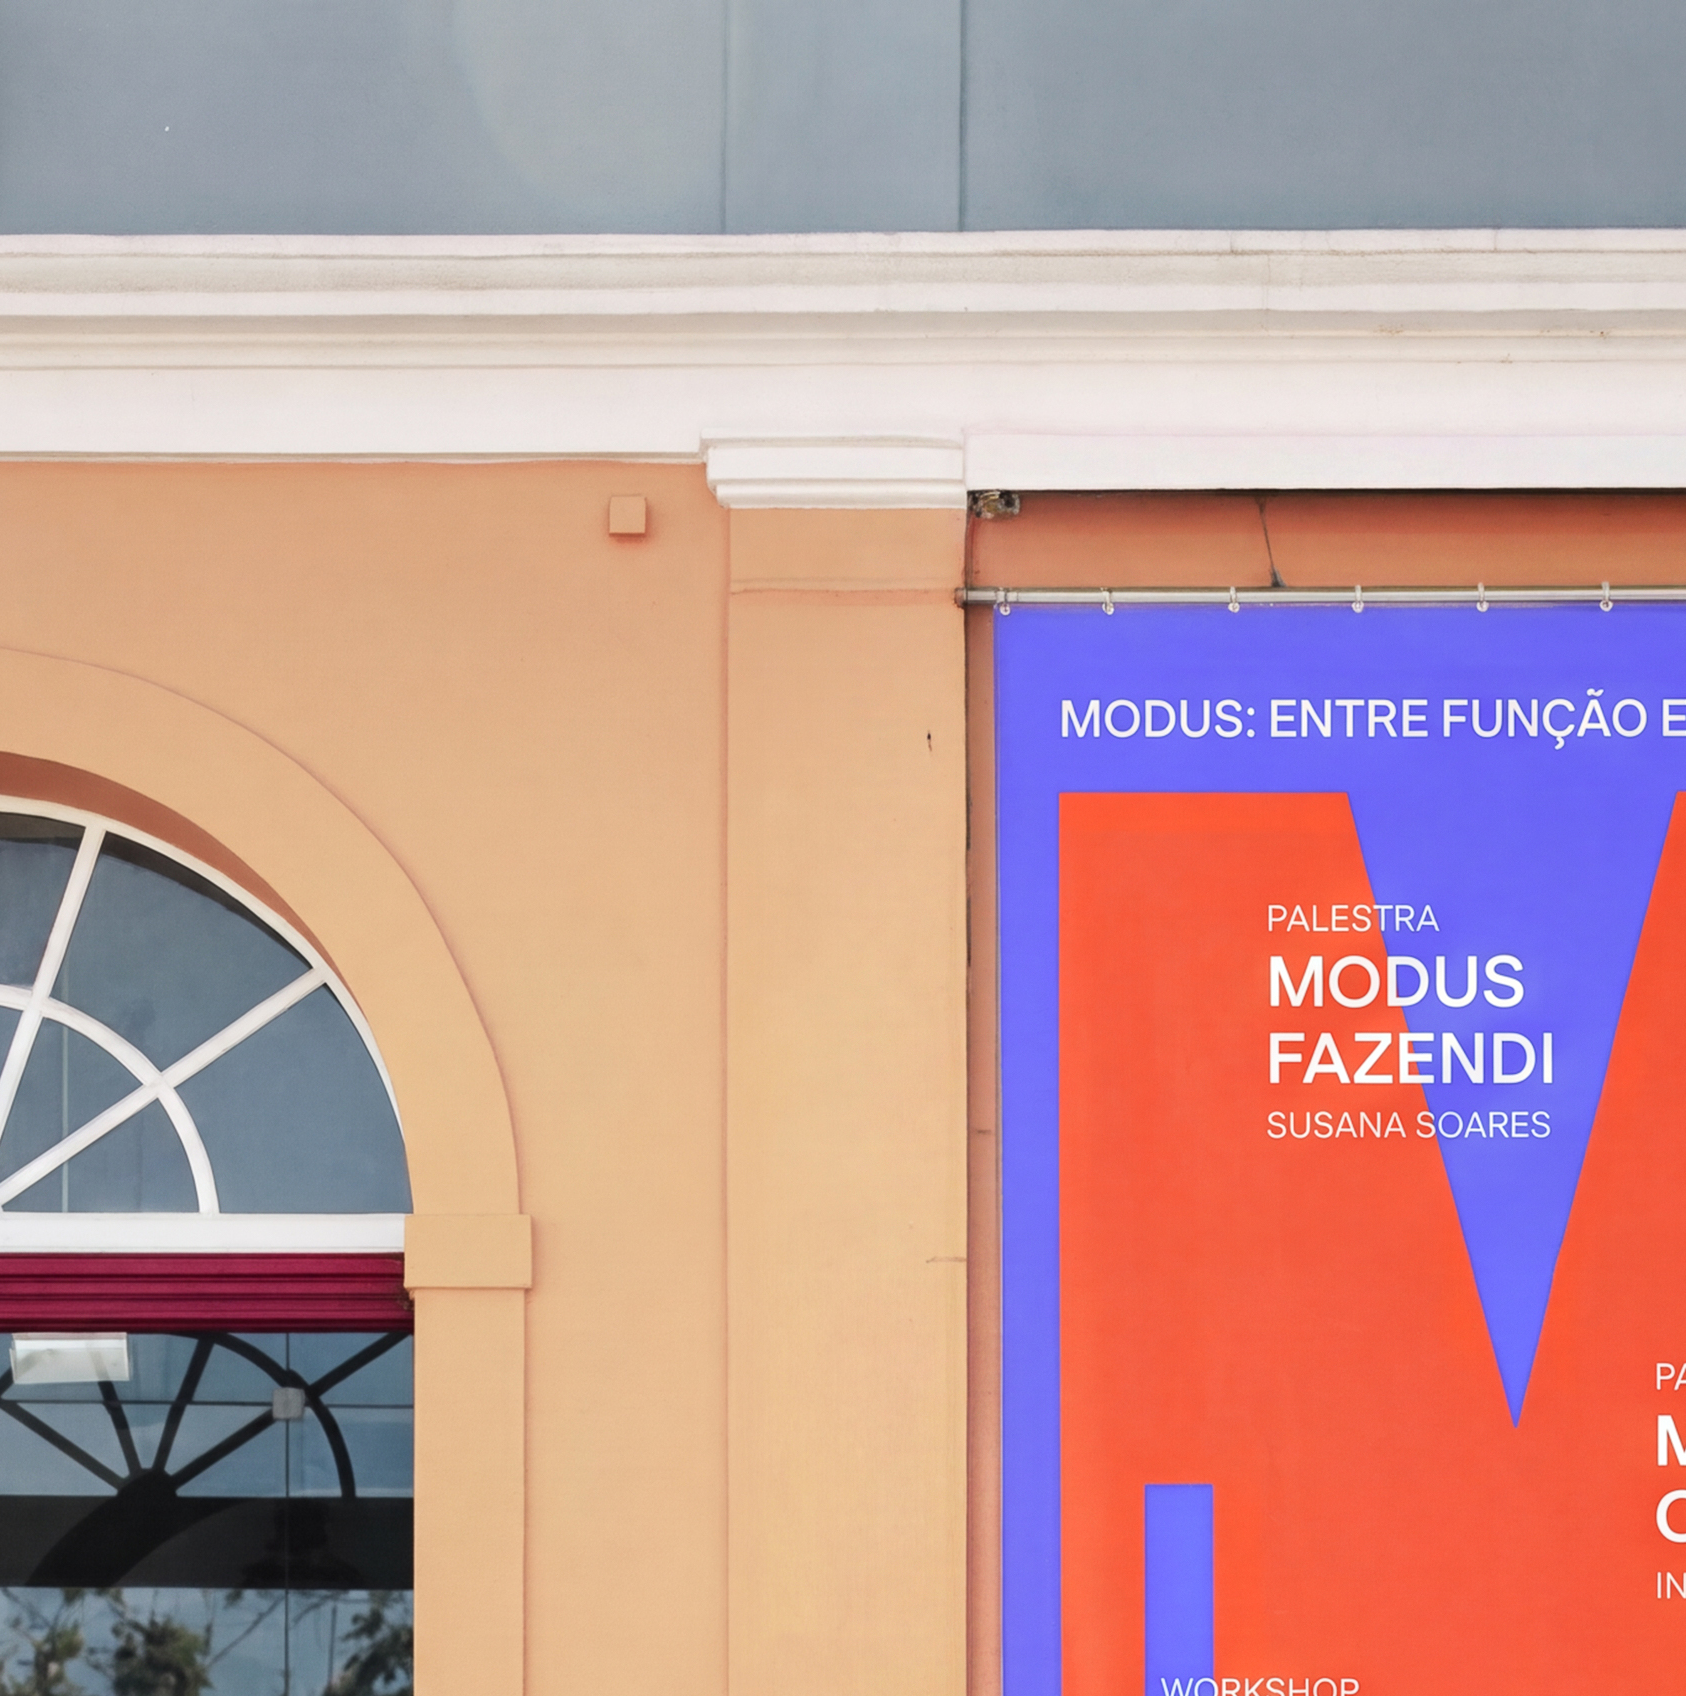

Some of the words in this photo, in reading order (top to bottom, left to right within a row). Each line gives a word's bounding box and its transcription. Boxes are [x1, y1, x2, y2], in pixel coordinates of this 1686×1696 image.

[1061, 699, 1255, 738] MODUS:
[1270, 699, 1429, 738] ENTRE
[1443, 688, 1647, 750] FUNÇÃO
[1268, 904, 1440, 932] PALESTRA
[1270, 954, 1524, 1008] MODUS
[1269, 1032, 1553, 1084] FAZENDI
[1267, 1111, 1406, 1139] SUSANA
[1416, 1110, 1551, 1139] SOARES
